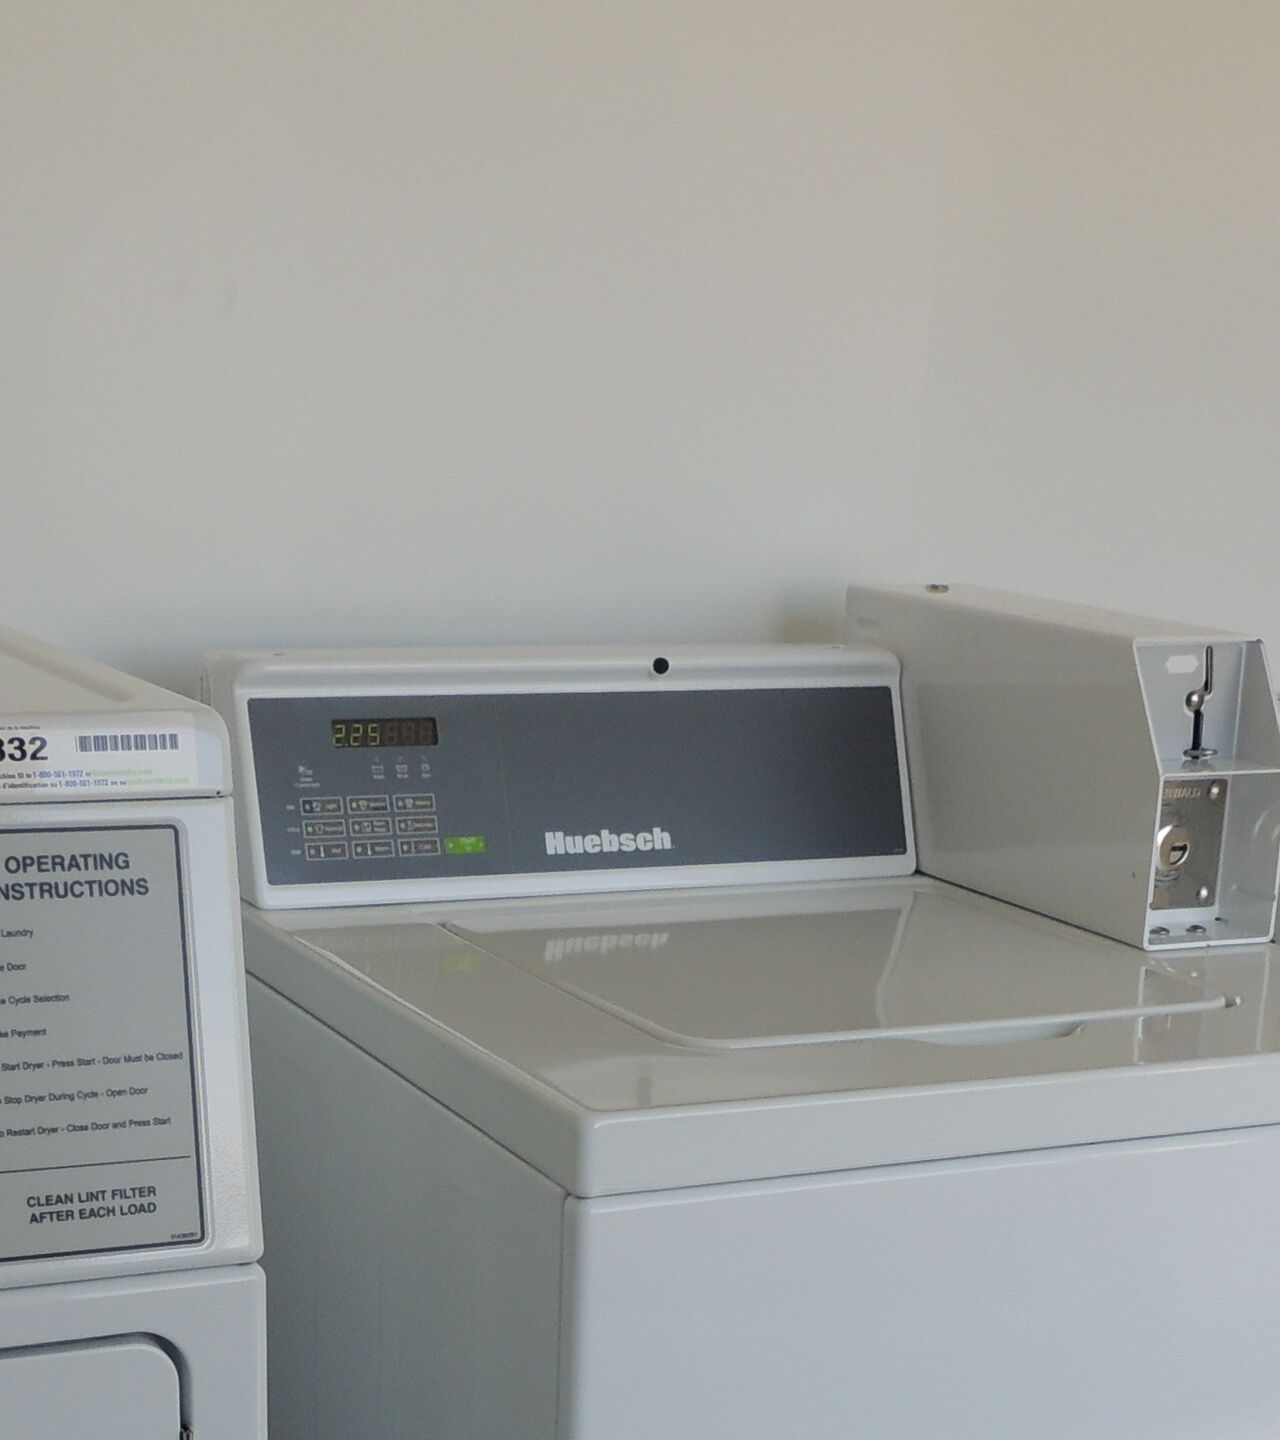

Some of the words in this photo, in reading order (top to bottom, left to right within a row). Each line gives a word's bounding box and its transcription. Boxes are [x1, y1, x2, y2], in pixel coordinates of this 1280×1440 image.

[544, 827, 672, 856] Huebsch
[4, 852, 130, 875] OPERATING
[1, 929, 33, 939] Laundry
[7, 963, 26, 971] Door
[9, 996, 30, 1006] Cycle
[33, 994, 70, 1003] Selection
[11, 1028, 46, 1038] Payment
[1, 1063, 20, 1072] Start
[23, 1061, 44, 1071] Dryer
[52, 1059, 74, 1068] Press
[77, 1058, 95, 1067] Start
[103, 1057, 121, 1065] Door
[124, 1055, 142, 1064] Must
[145, 1054, 154, 1062] be
[157, 1052, 183, 1061] Closed
[4, 1096, 22, 1105] Stop
[25, 1094, 46, 1104] Dryer
[49, 1092, 74, 1102] During
[77, 1091, 98, 1100] Cycle
[106, 1089, 127, 1098] Open
[129, 1087, 148, 1096] Door
[7, 1127, 35, 1137] Restart
[38, 1126, 58, 1136] Dryer
[67, 1124, 88, 1133] Close
[91, 1122, 109, 1131] Door
[112, 1121, 126, 1129] and
[129, 1119, 150, 1128] Press
[153, 1117, 170, 1126] Start
[26, 1190, 74, 1208] CLEAN
[78, 1188, 106, 1205] LINT
[111, 1186, 156, 1202] FILTER
[30, 1207, 75, 1224] AFTER
[79, 1205, 116, 1220] EACH
[120, 1201, 156, 1217] LOAD
